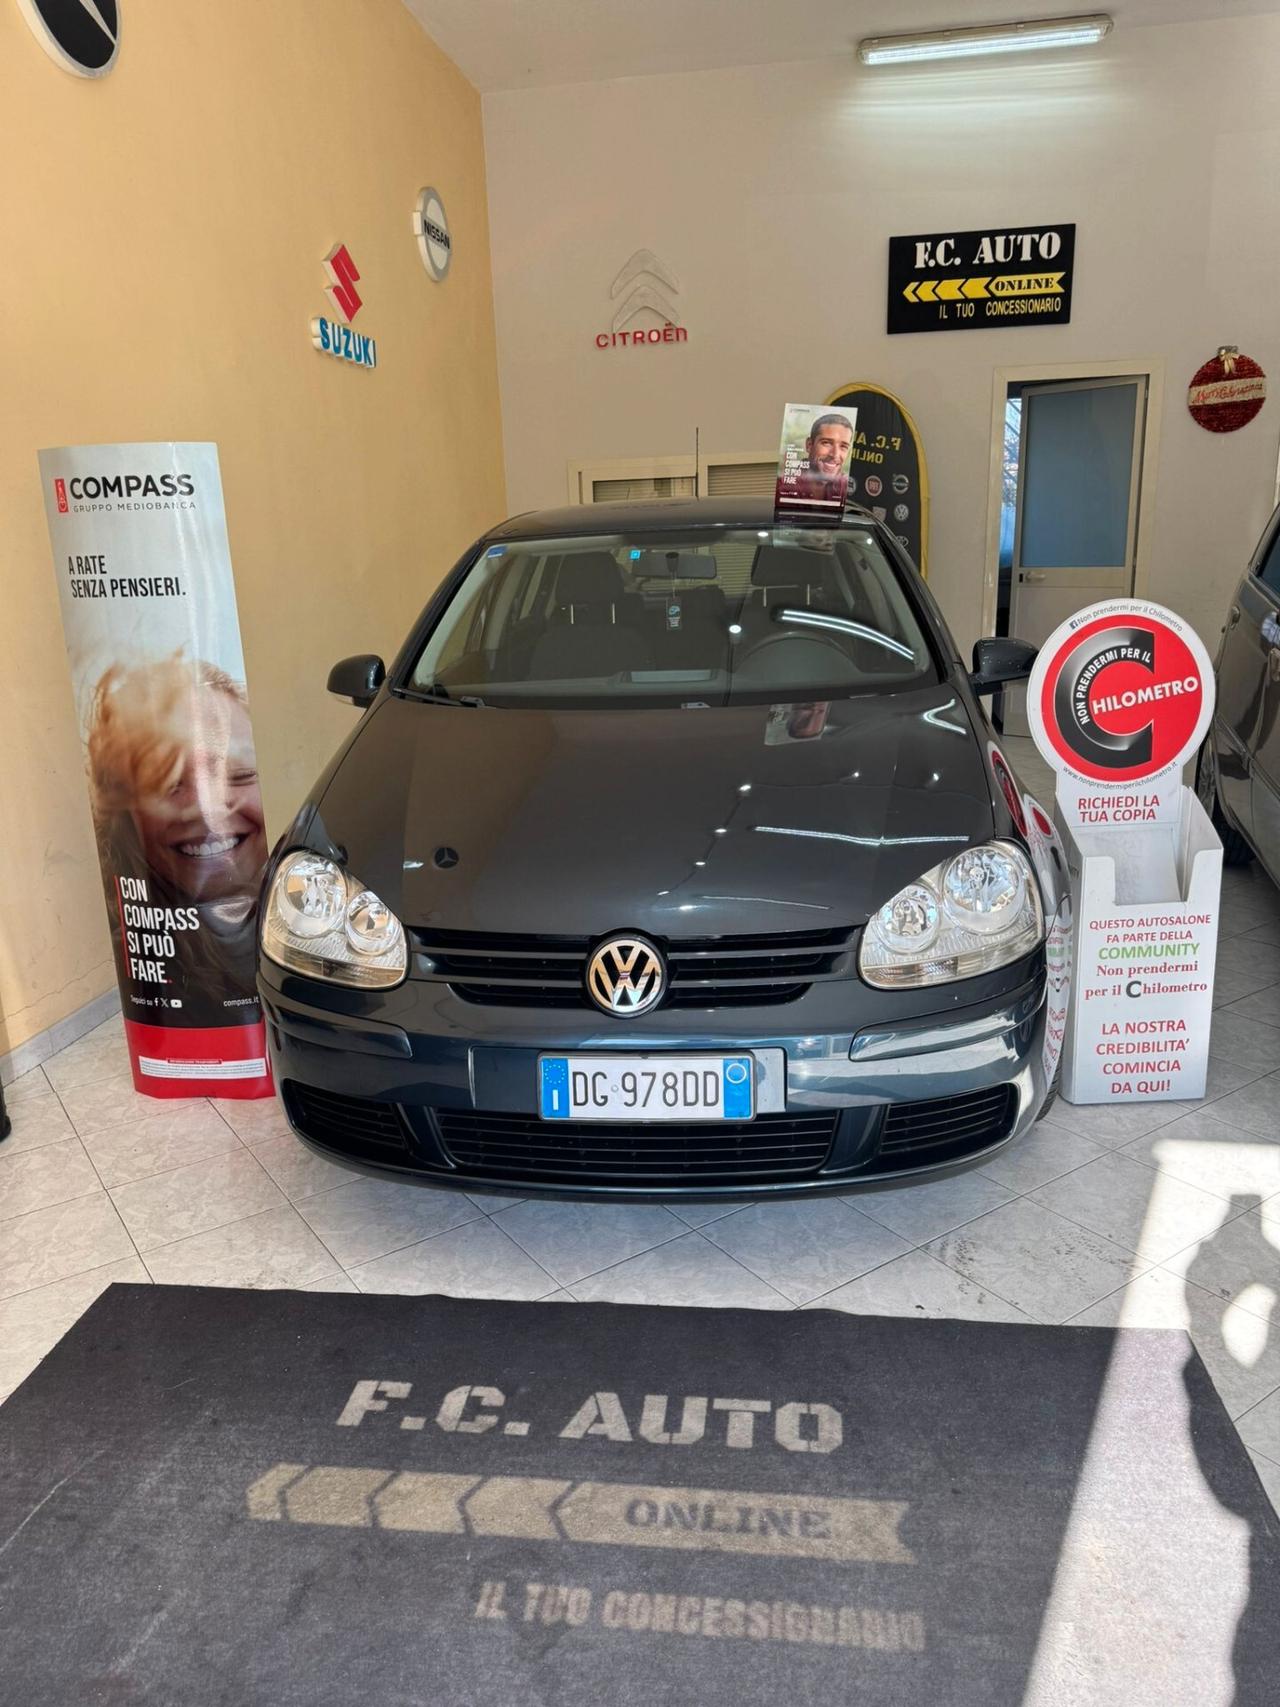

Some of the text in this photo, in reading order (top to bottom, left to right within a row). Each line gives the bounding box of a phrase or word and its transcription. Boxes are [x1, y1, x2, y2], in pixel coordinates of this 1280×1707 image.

[423, 219, 450, 250] NISSAN
[914, 231, 1062, 268] F.C. AUTO
[995, 277, 1054, 292] ONLINE
[939, 297, 1062, 319] IL TUO CONCESSIONARIO
[319, 317, 377, 368] SUZUKI
[70, 474, 195, 500] COMPASS
[73, 501, 197, 513] GRUPPO MEDIOBANCA
[68, 555, 107, 576] A RATE
[71, 576, 187, 599] SENZA PENSIERI.
[1077, 613, 1093, 625] Non
[1092, 603, 1129, 618] prendermi
[1130, 605, 1142, 613] per
[1149, 607, 1183, 632] Chilometro
[1075, 647, 1152, 725] NON PRENDERMI PER IL
[1078, 794, 1160, 810] RICHIEDI LA
[1080, 809, 1157, 823] TUA COPIA
[119, 876, 148, 902] CON
[124, 904, 200, 931] COMPASS
[1089, 914, 1212, 930] QUESTO AUTOSALONE
[127, 930, 176, 958] SI PUÒ
[1106, 930, 1193, 944] FA PARTE DELLA
[1098, 943, 1200, 960] COMMUNITY
[1096, 960, 1199, 979] Non prendermi
[1085, 980, 1208, 1000] per il Chilometro
[223, 996, 260, 1008] compass.it
[1102, 1019, 1187, 1035] LA NOSTRA
[1102, 1059, 1181, 1075] COMINCIA
[1111, 1079, 1171, 1094] DA QUI!
[335, 1379, 844, 1454] F.C. AUTO
[624, 1498, 833, 1541] ONLINE
[474, 1580, 507, 1620] IL
[523, 1582, 593, 1626] TUO
